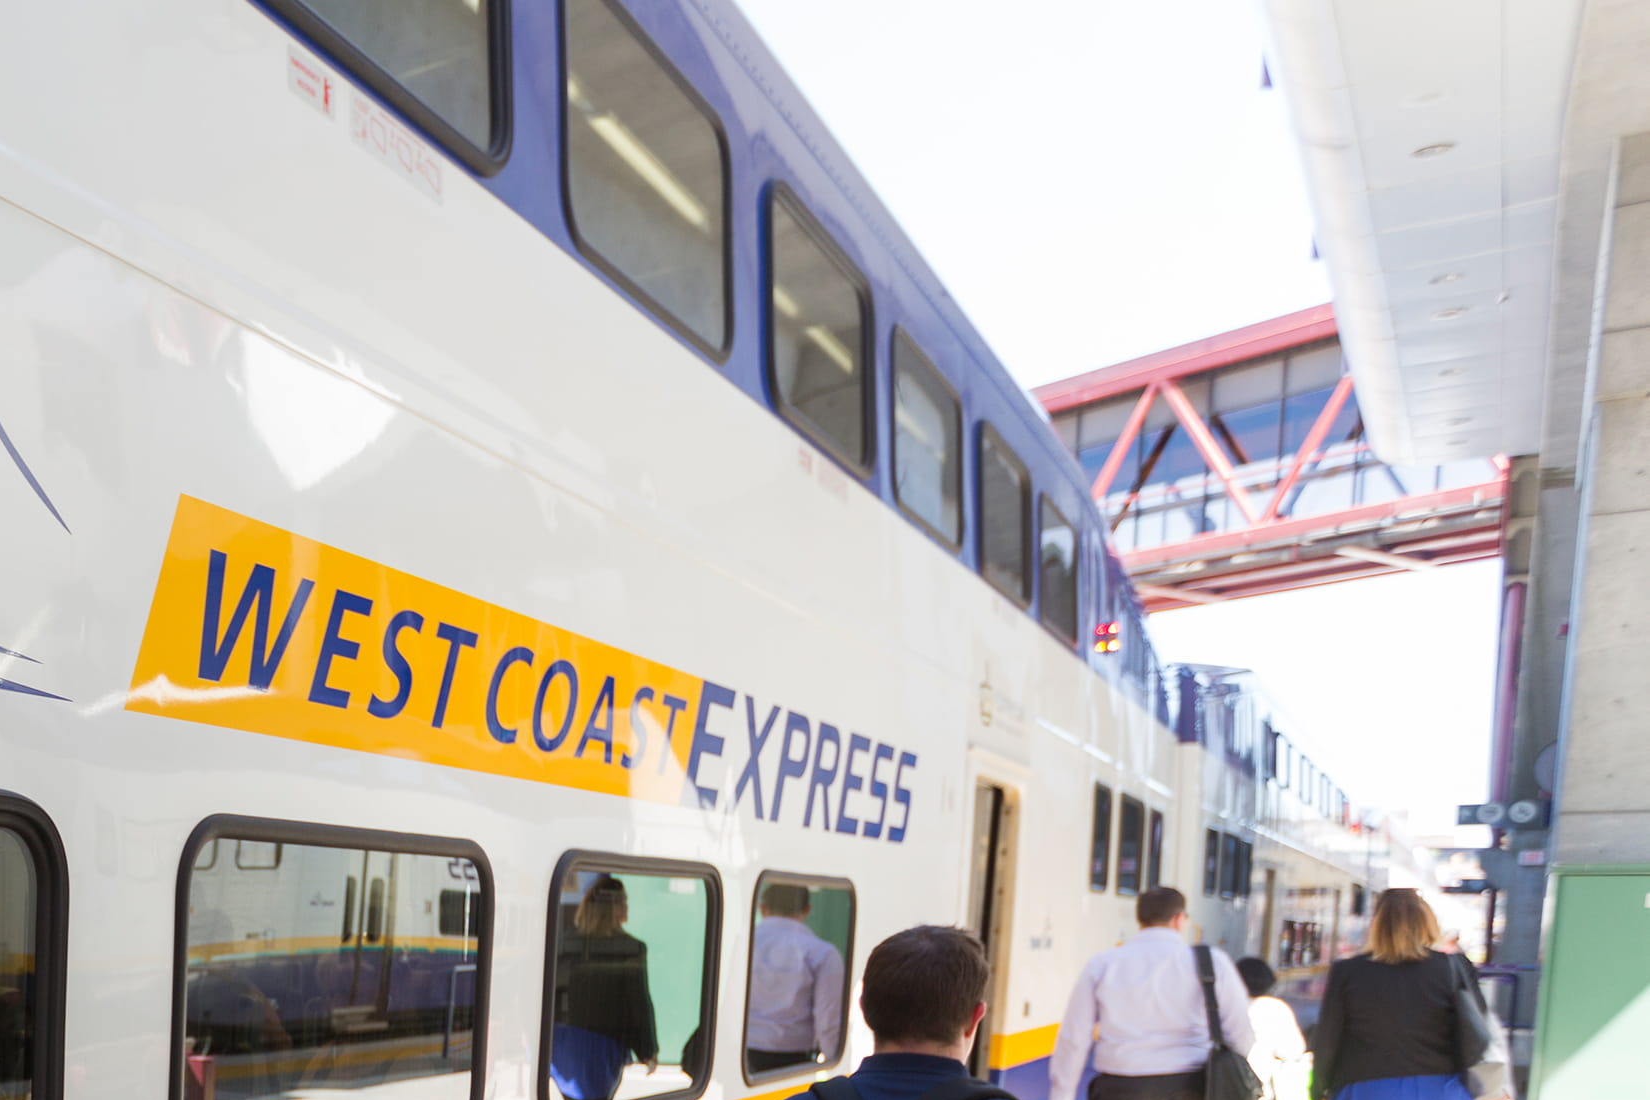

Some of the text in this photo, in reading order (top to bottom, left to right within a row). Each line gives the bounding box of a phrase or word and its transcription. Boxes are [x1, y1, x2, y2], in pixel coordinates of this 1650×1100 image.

[197, 548, 919, 843] WEST COAST EXPRESS
